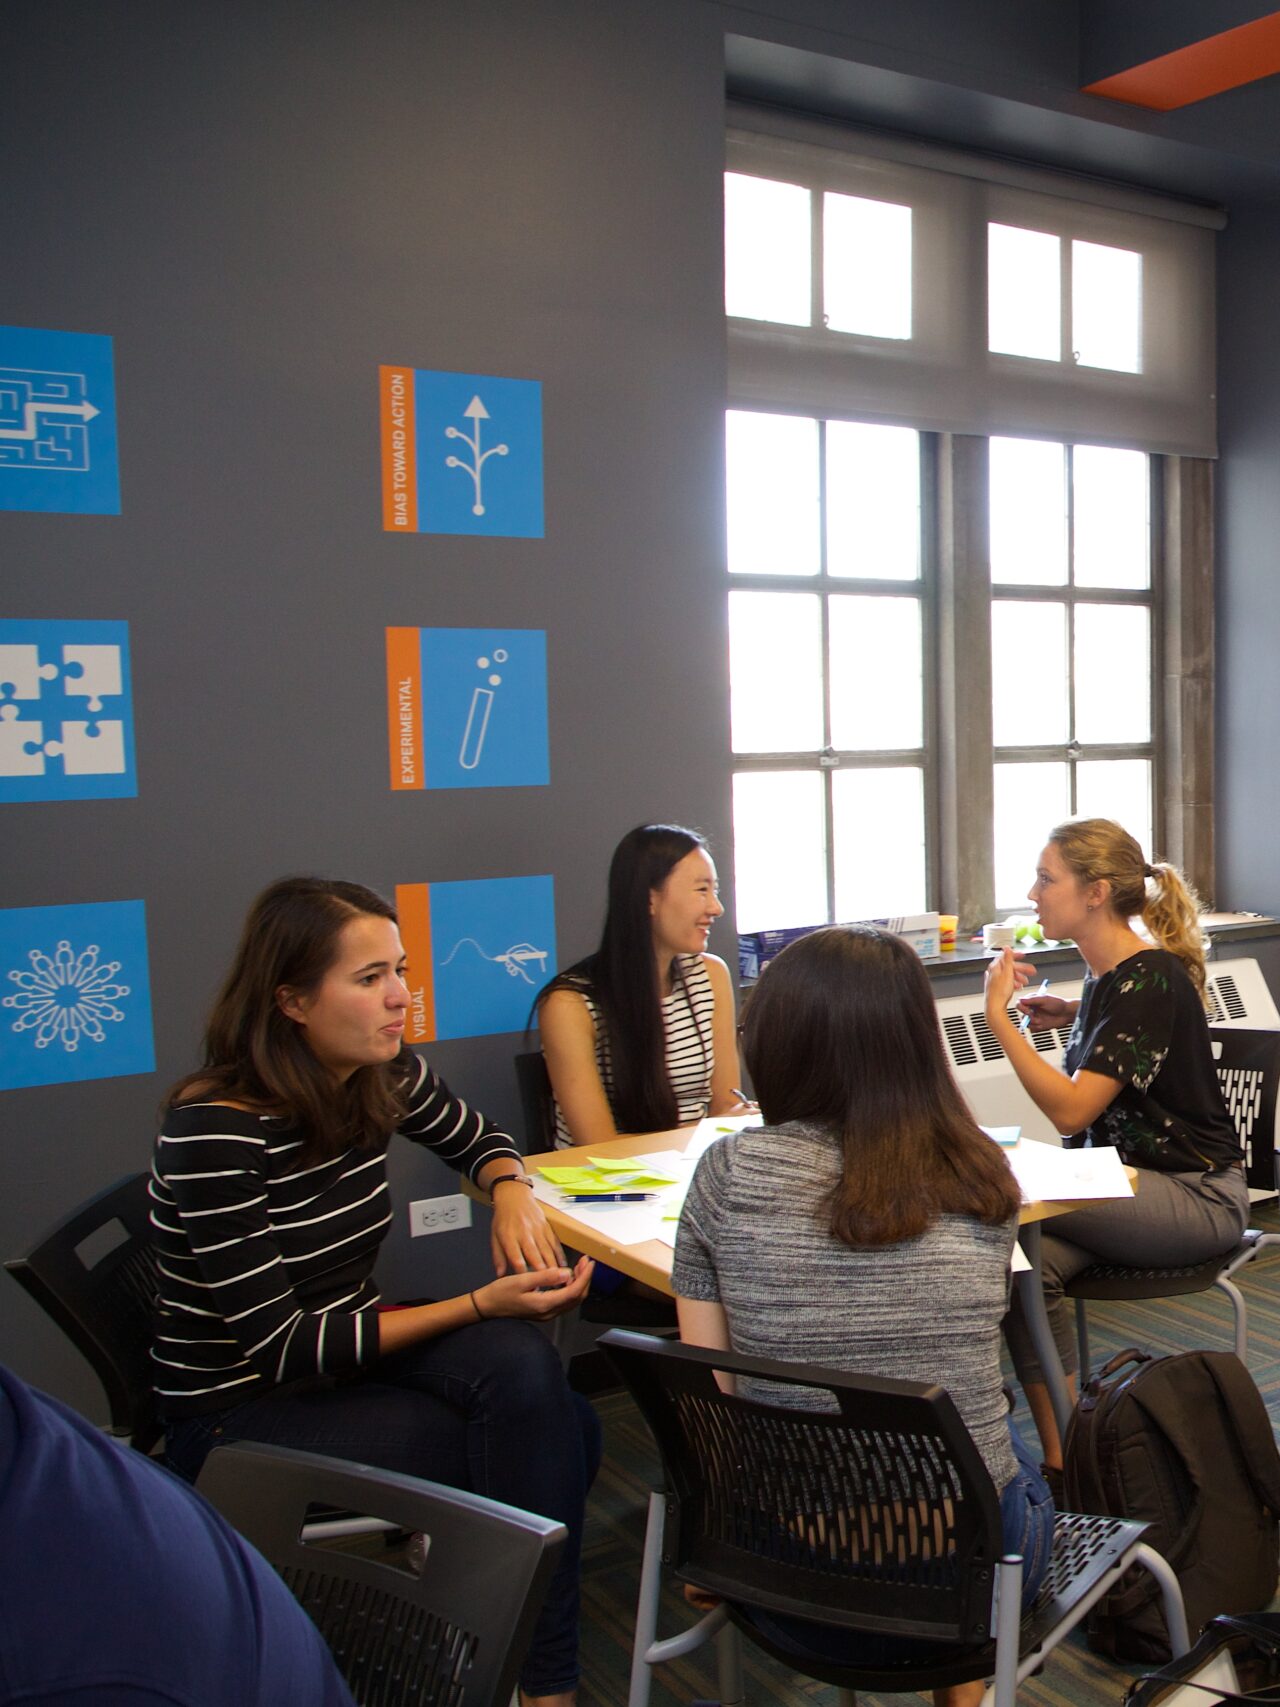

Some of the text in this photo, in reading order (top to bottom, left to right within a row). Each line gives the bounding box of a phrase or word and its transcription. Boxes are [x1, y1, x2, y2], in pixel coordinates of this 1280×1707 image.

[391, 374, 408, 525] BIAS TOWARD ACTION
[399, 676, 415, 784] EXPERIMENTAL
[411, 986, 427, 1038] VISUAL
